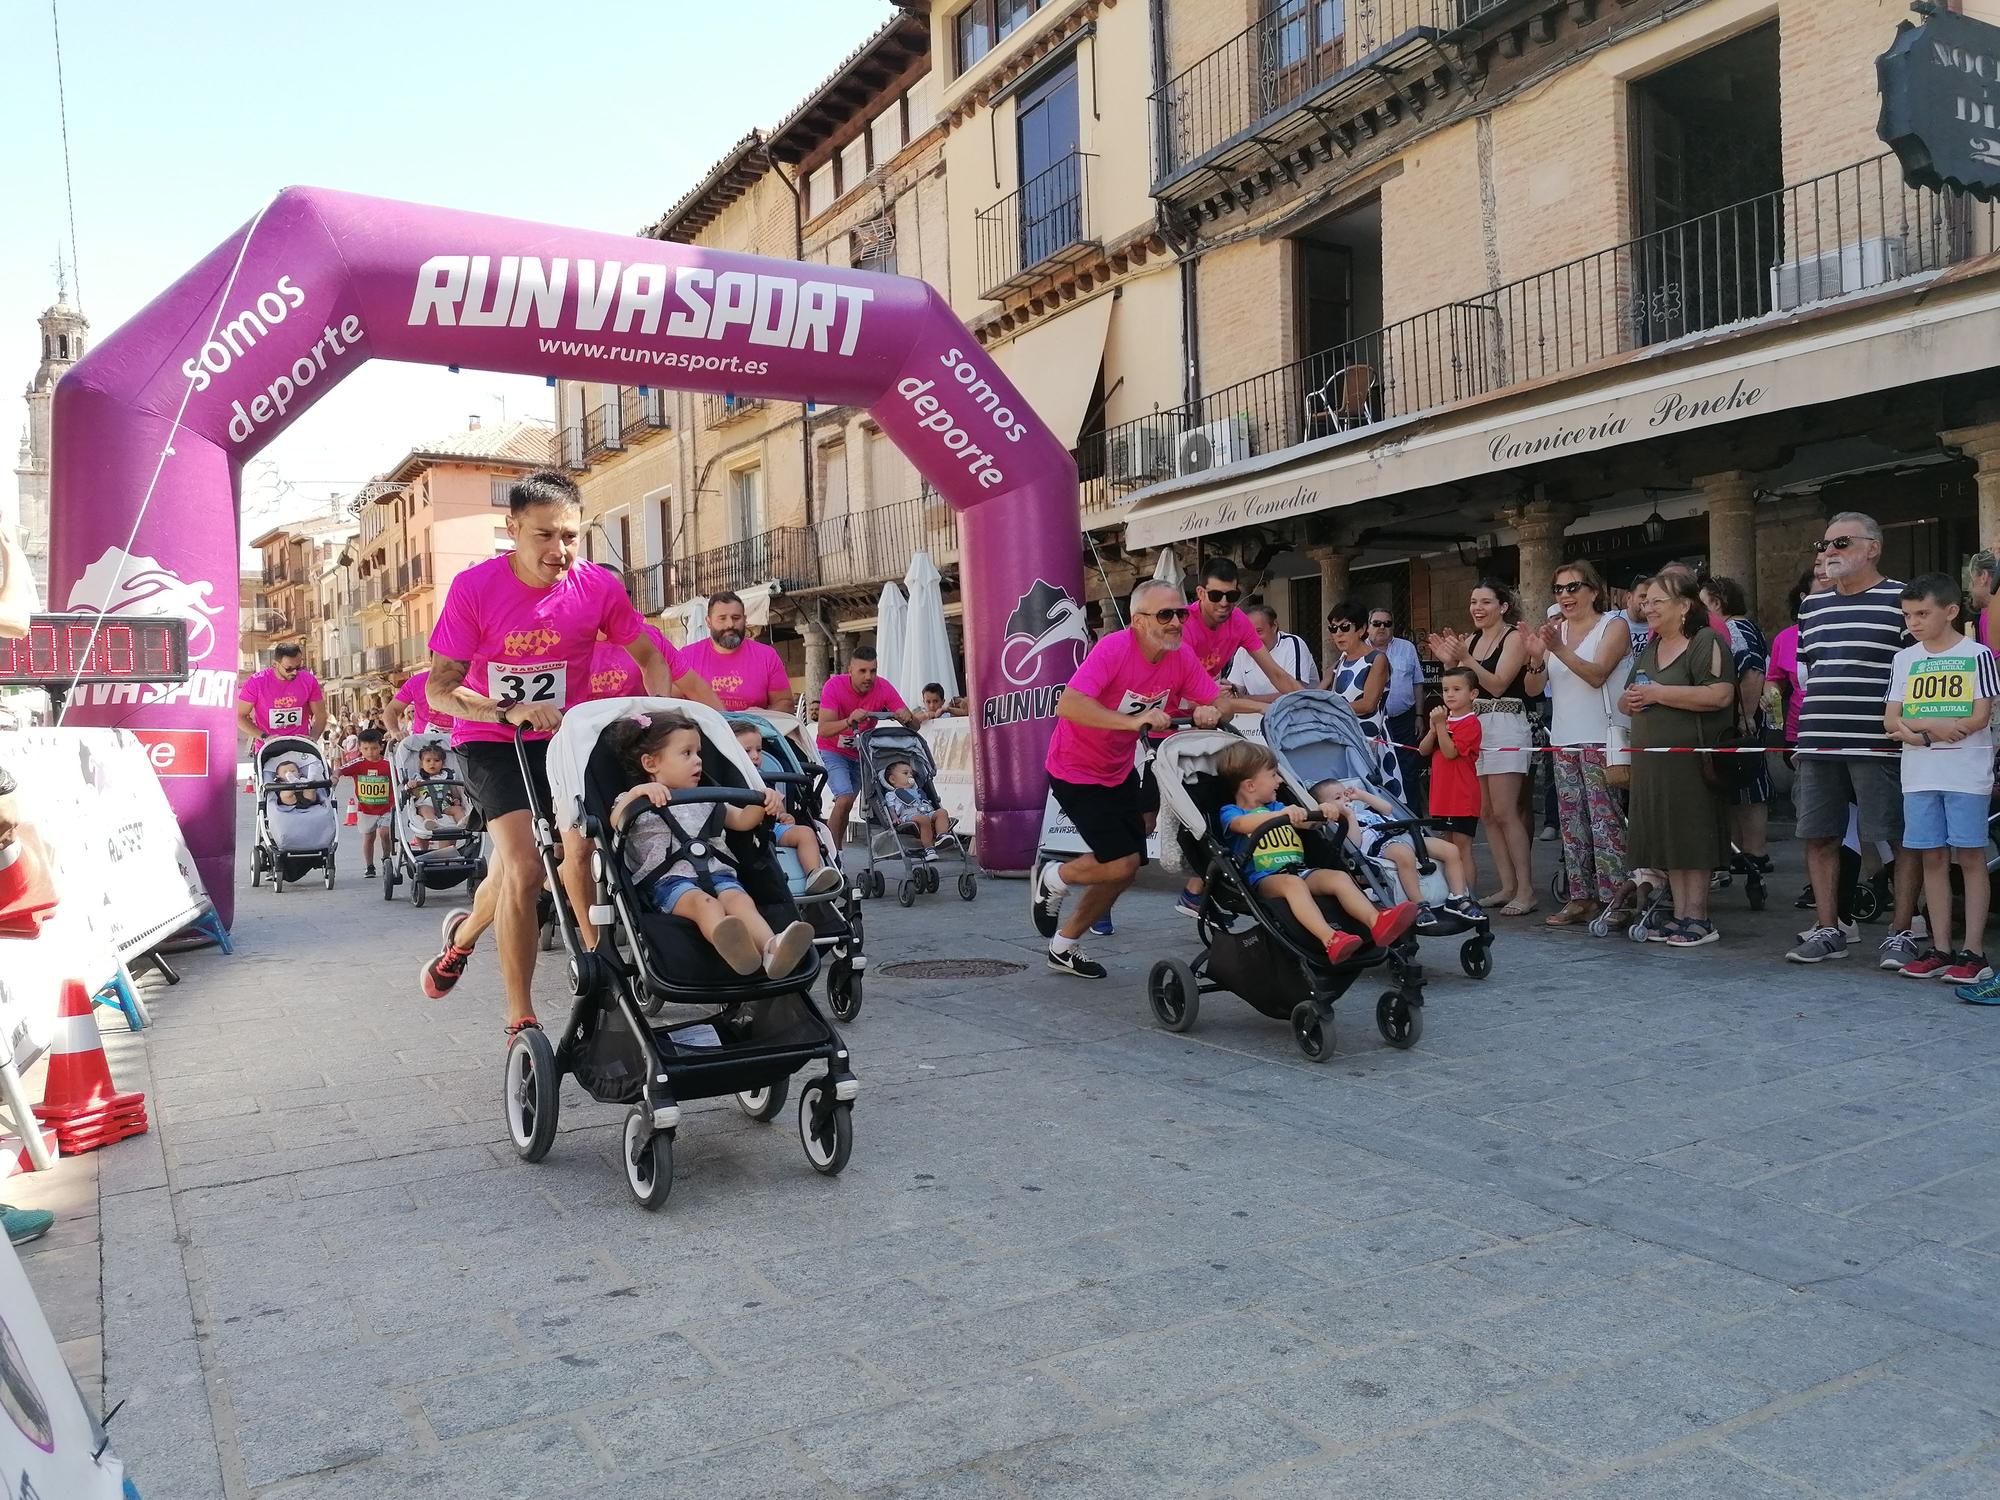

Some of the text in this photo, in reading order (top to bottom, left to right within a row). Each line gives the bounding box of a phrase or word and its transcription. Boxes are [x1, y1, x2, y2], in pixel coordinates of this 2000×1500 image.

[1931, 41, 2000, 82] NOC
[182, 274, 305, 392] somos
[538, 338, 768, 376] www.runvasport.es
[228, 314, 364, 443] deporte
[940, 348, 1027, 442] somos
[897, 377, 1003, 489] deporte
[1488, 378, 1769, 463] Carnicería Peneke
[1179, 485, 1323, 533] Bar La Comedia
[1567, 533, 1648, 553] OMEDIA
[500, 673, 556, 702] 32
[983, 683, 1067, 729] RUNVA
[1912, 674, 1963, 699] 0018
[274, 711, 298, 724] 26
[1940, 703, 1968, 712] RURAL
[360, 783, 386, 796] 0004
